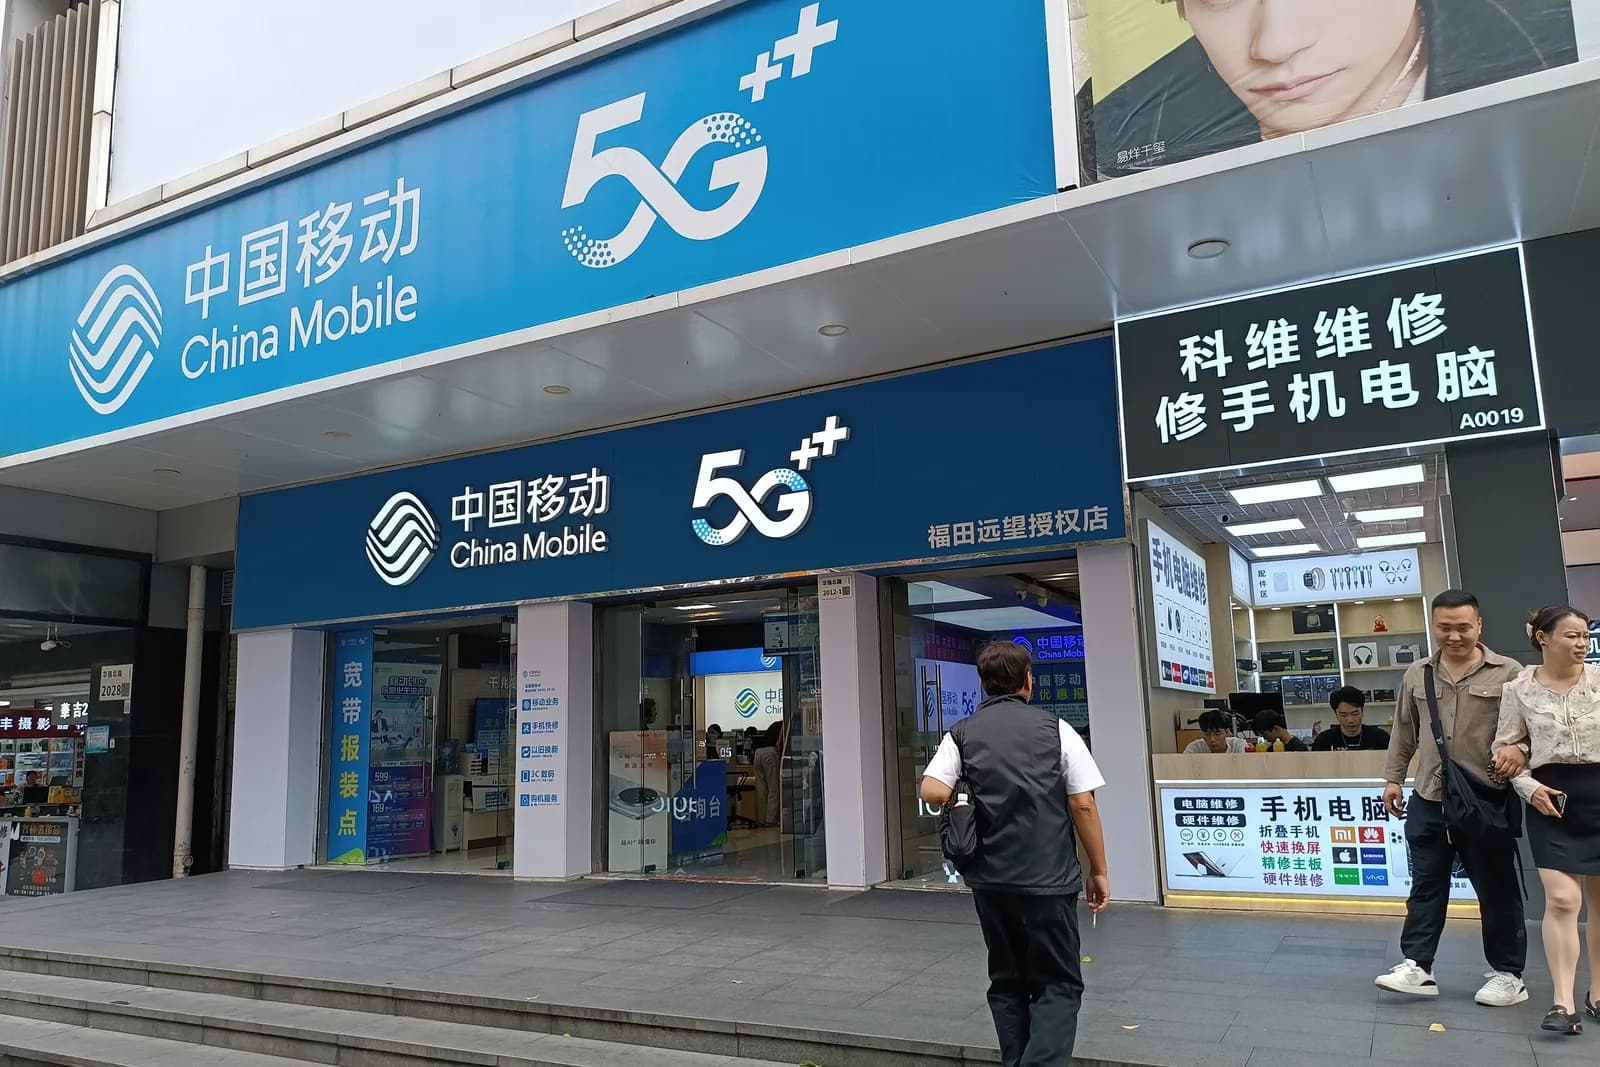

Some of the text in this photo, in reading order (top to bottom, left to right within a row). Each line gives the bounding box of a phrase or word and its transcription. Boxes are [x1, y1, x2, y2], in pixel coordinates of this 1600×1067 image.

[1116, 141, 1167, 164] 易烊千玺
[184, 177, 420, 320] 中国移动
[181, 276, 417, 380] China Mobile
[1179, 292, 1448, 382] 科维维修
[1155, 346, 1498, 444] 修手机电脑
[1459, 407, 1524, 429] A0019
[451, 467, 609, 532] 中国移动
[928, 505, 1109, 549] 福田远望授权店
[450, 523, 607, 568] China Mobile
[1152, 537, 1207, 606] 手机电脑维修
[1257, 569, 1268, 598] 配件区
[1038, 648, 1085, 659] China Mobi
[101, 685, 121, 696] 2028
[1032, 673, 1081, 687] 国移动
[338, 661, 363, 836] 宽带报装点
[1181, 799, 1239, 809] 电脑维修
[1182, 815, 1240, 826] 硬件维修
[1259, 825, 1320, 838] 折叠手机
[1260, 841, 1321, 855] 快速换屏
[1261, 856, 1322, 870] 精修主板
[1263, 873, 1324, 887] 硬件维修
